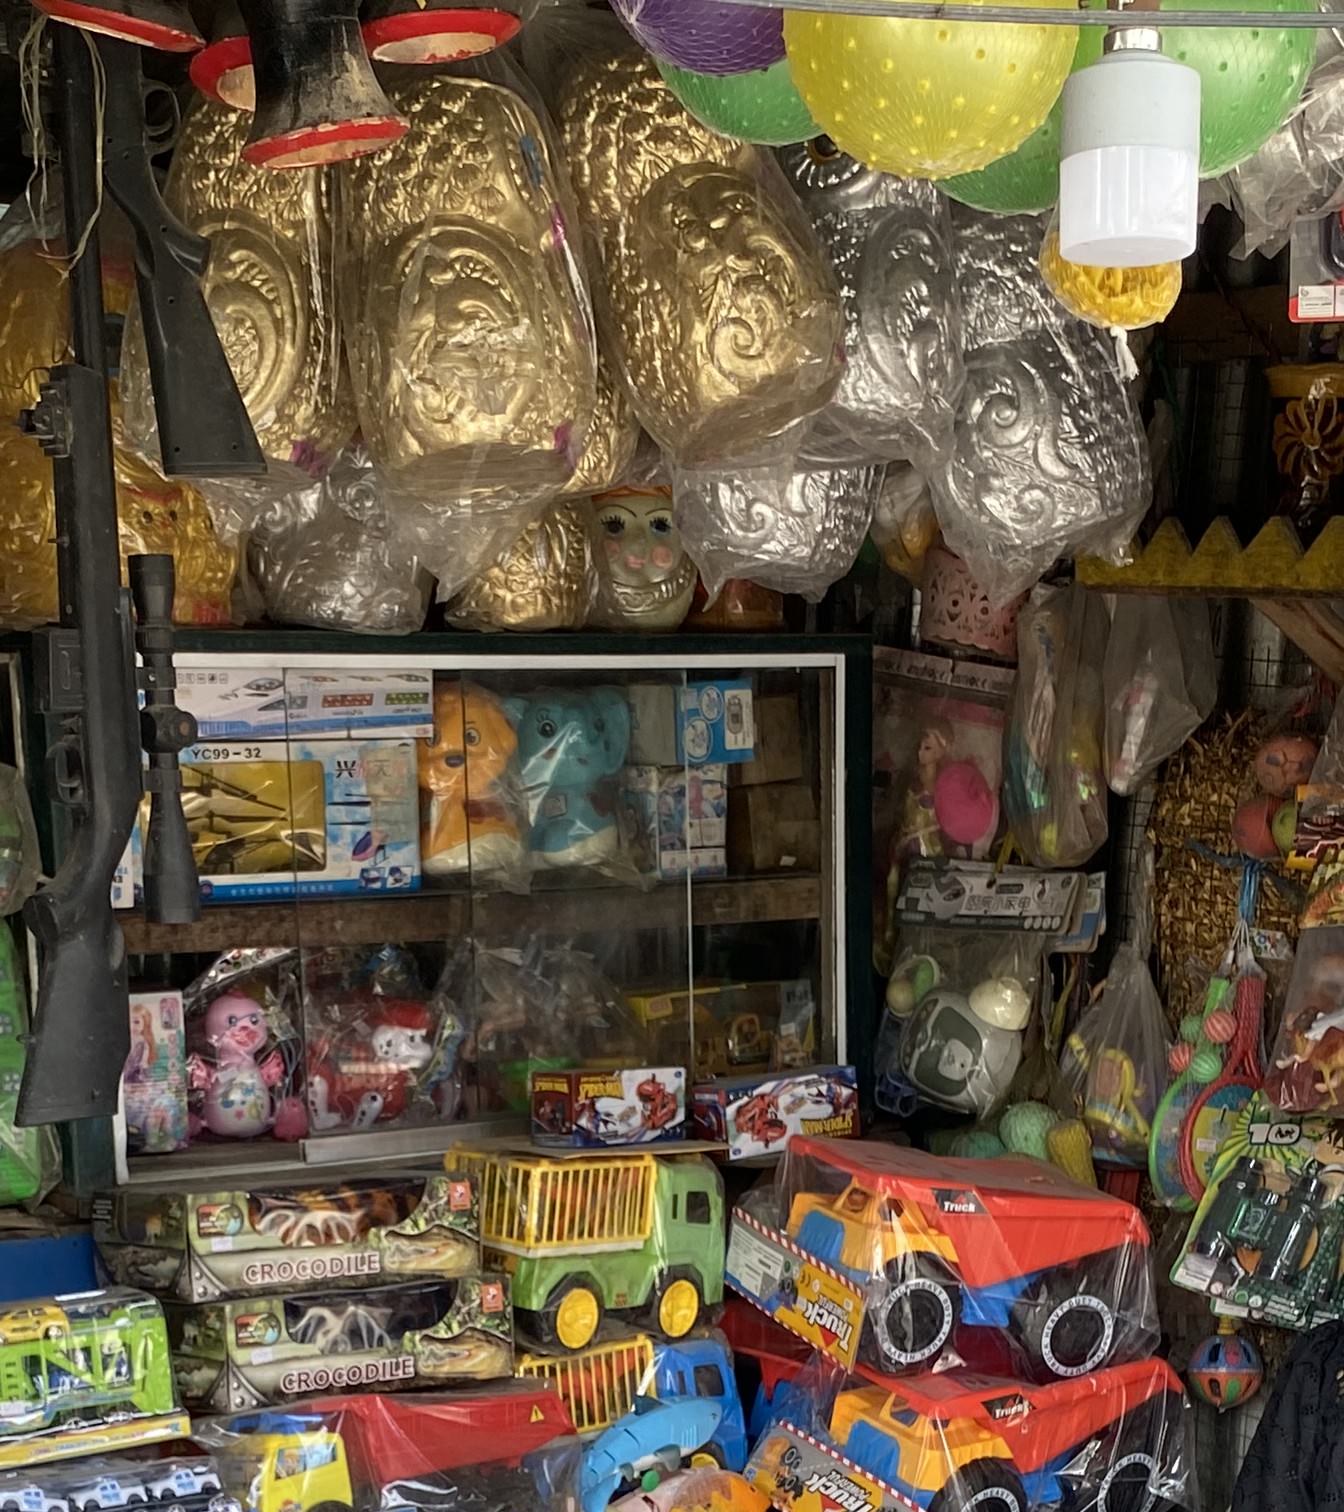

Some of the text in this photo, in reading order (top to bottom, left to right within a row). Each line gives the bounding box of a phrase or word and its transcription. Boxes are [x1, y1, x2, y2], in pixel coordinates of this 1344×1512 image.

[943, 1201, 976, 1213] Truck
[243, 1250, 380, 1285] CROCODILE
[280, 1355, 416, 1394] CROCODILE
